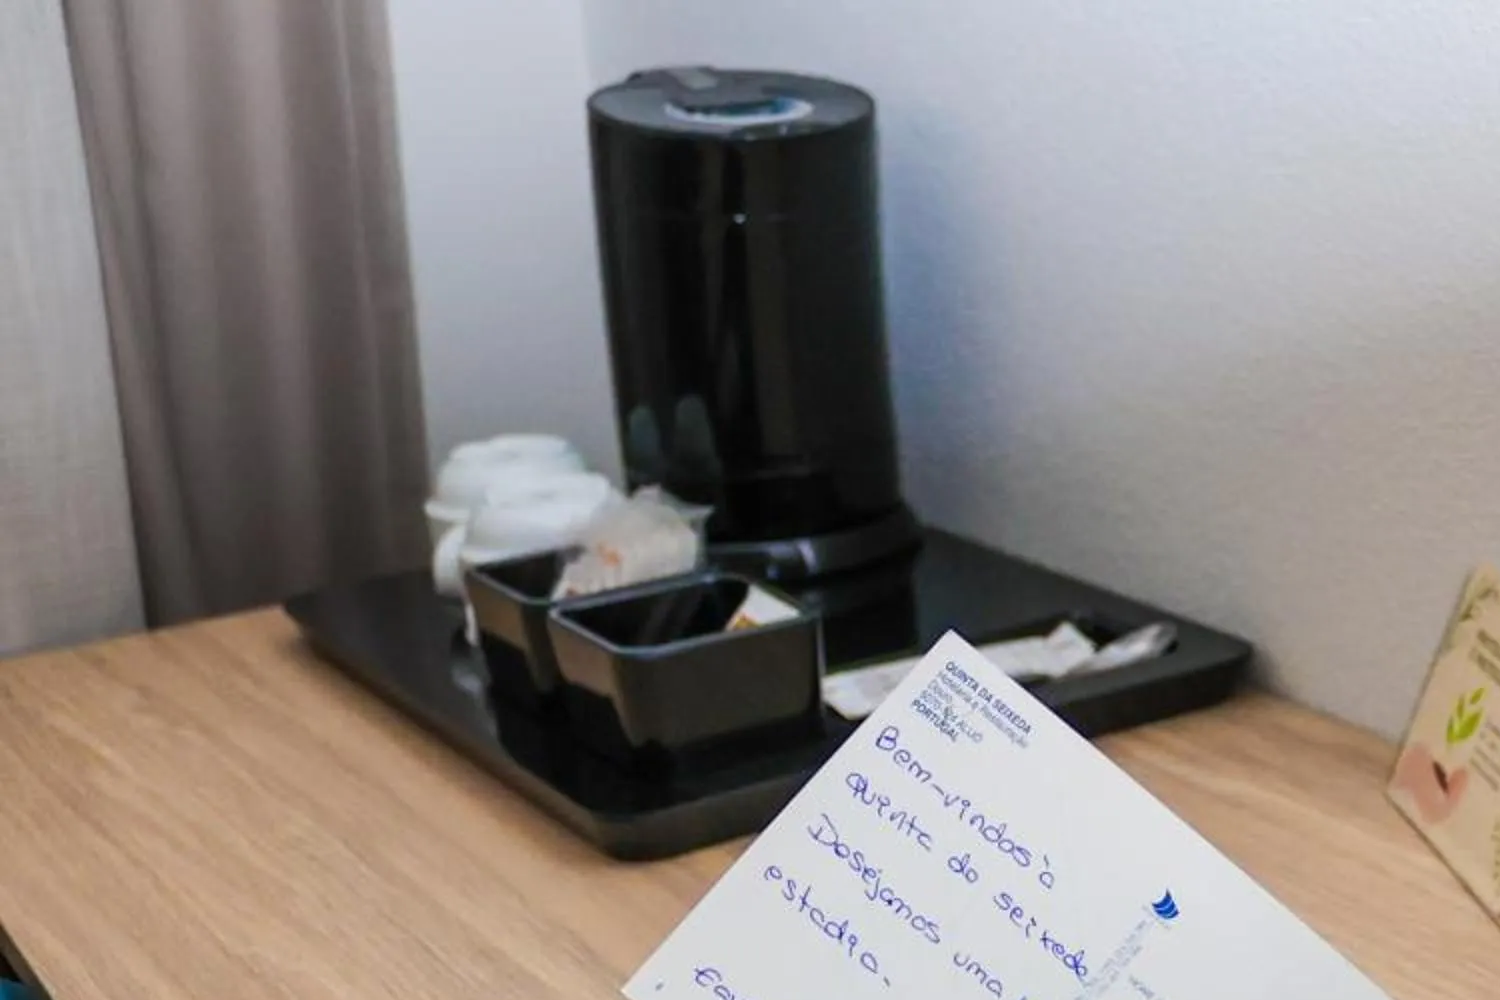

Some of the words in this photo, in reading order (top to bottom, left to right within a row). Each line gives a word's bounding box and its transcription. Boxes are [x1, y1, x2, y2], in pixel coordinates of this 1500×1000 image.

[910, 697, 960, 743] PORTUGAL
[945, 660, 979, 692] QUINTA
[992, 699, 1032, 736] SEIXEDA
[953, 952, 1003, 1000] uma
